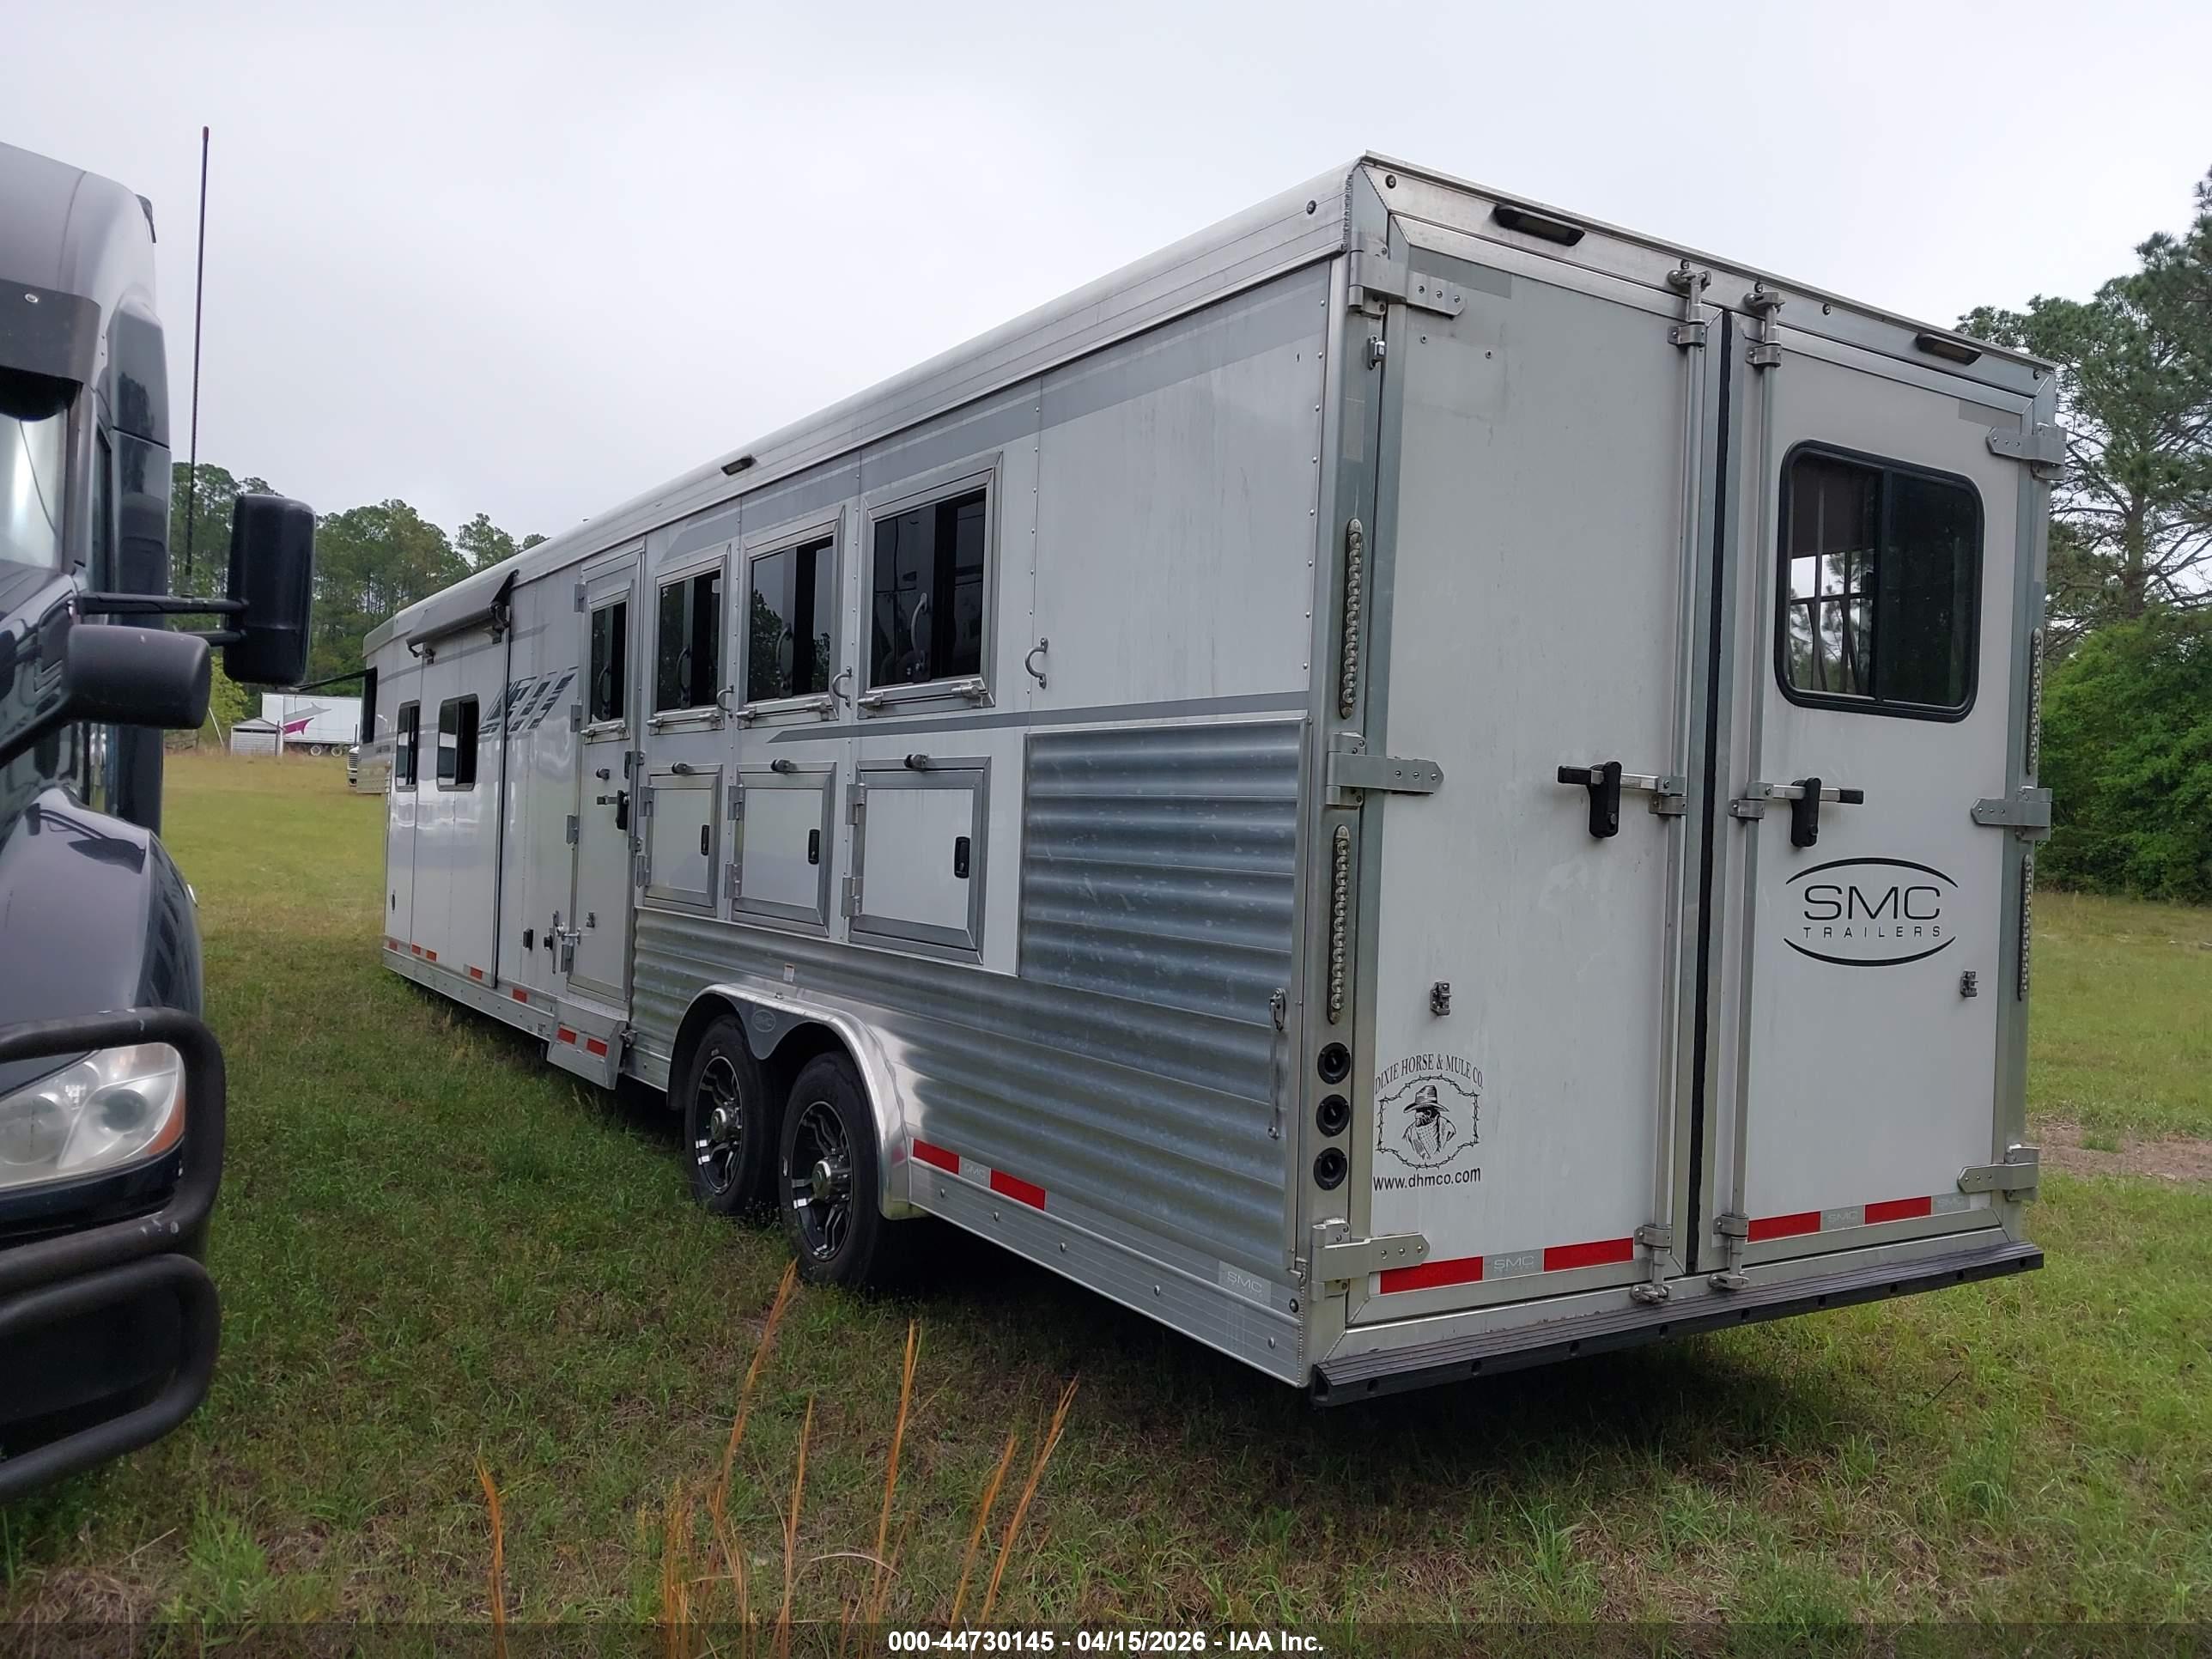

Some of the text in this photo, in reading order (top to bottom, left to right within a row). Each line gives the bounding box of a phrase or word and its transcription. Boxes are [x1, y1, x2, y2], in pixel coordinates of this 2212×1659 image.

[1803, 884, 1941, 921] SMC
[1803, 926, 1941, 939] TRAILERS
[1375, 1062, 1400, 1095] DIXIE
[1401, 1054, 1434, 1077] HORSE
[1436, 1054, 1443, 1070] &
[1445, 1054, 1471, 1079] MULE
[1372, 1168, 1481, 1192] www.dhmco.com
[1493, 1255, 1534, 1272] SMC
[1228, 1271, 1263, 1293] SMC
